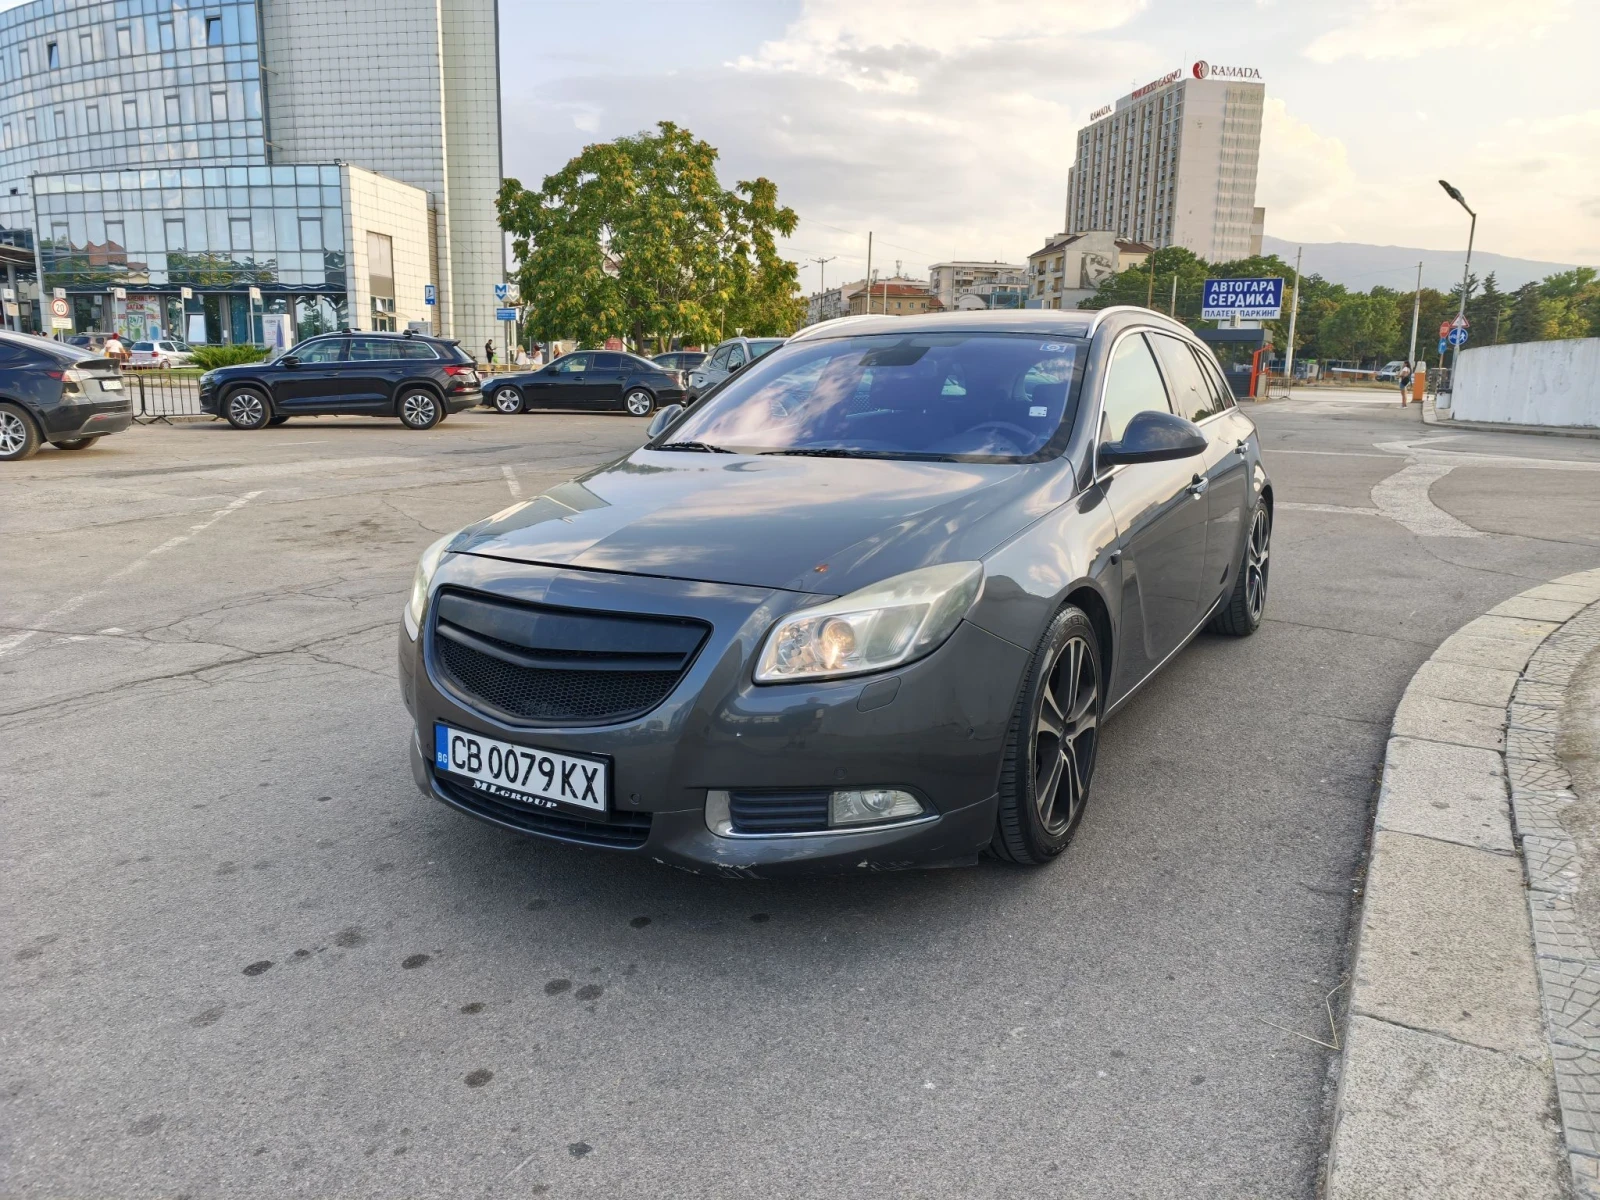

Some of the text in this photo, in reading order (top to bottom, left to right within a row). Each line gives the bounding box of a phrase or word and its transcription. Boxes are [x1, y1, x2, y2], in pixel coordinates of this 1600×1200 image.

[1158, 68, 1182, 88] CASINO
[1211, 65, 1262, 79] RAMADA
[1090, 104, 1112, 121] RAMADA
[1211, 281, 1275, 292] АВТОГАРА
[1208, 293, 1275, 307] СЕРДИКА
[56, 303, 65, 313] 20
[1239, 309, 1278, 317] ПАРКИНГ
[129, 315, 143, 323] 24/7
[437, 751, 448, 763] BG
